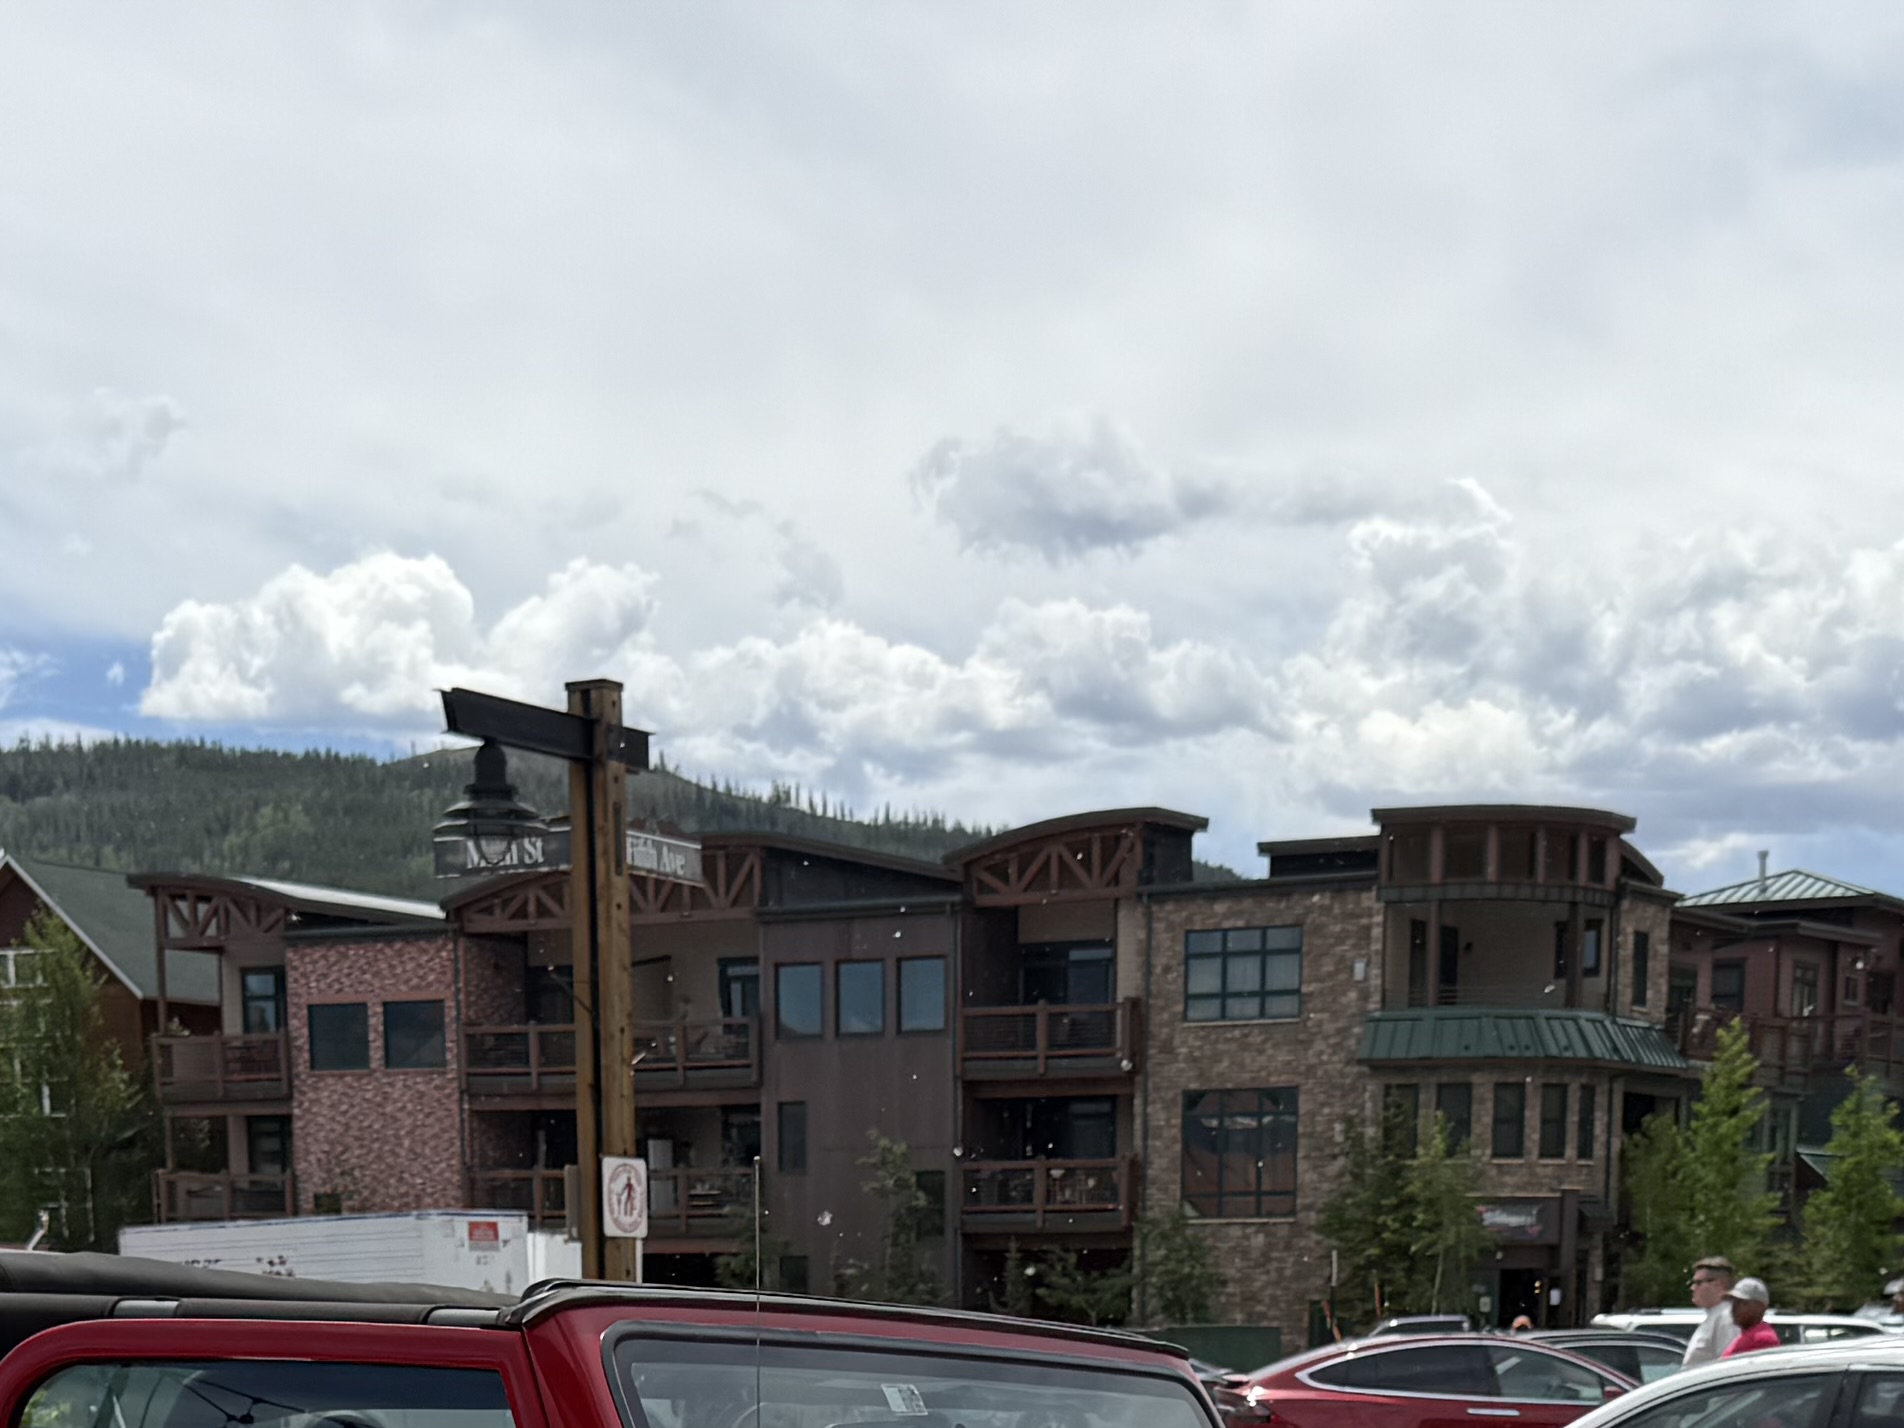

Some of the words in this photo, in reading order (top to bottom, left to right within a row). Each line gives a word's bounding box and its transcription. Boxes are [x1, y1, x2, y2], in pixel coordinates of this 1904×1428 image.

[466, 838, 518, 869] Mn
[524, 837, 545, 865] St
[659, 845, 686, 876] Ave
